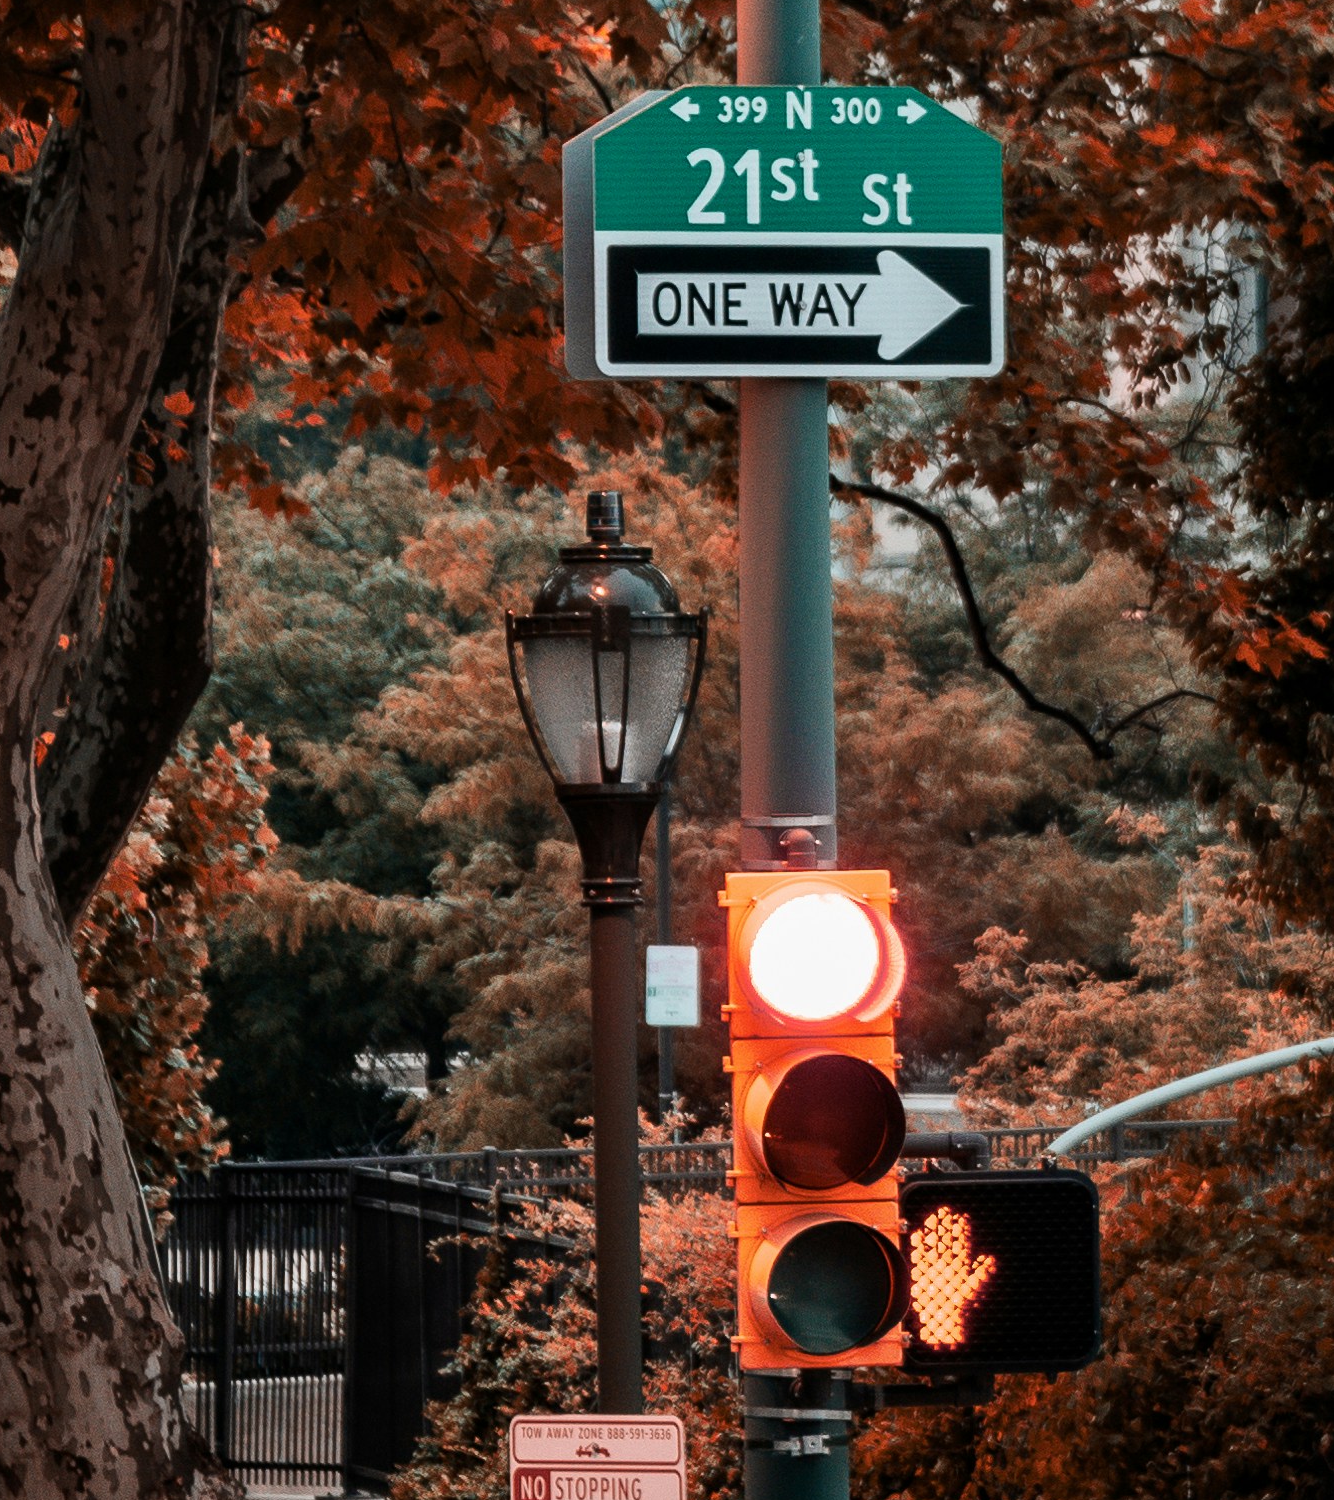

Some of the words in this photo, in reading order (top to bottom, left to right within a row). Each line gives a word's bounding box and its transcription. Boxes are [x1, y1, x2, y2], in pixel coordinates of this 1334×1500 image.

[717, 96, 767, 123] 399
[786, 91, 812, 130] N
[830, 98, 882, 125] 300
[686, 147, 819, 225] 21st
[862, 173, 913, 226] St
[651, 282, 748, 327] ONE
[768, 283, 867, 327] WAY
[521, 1427, 542, 1439] TOW
[546, 1427, 574, 1439] AWAY
[578, 1427, 603, 1439] ZONE
[607, 1427, 672, 1441] 888-591-3636
[520, 1475, 546, 1500] NO
